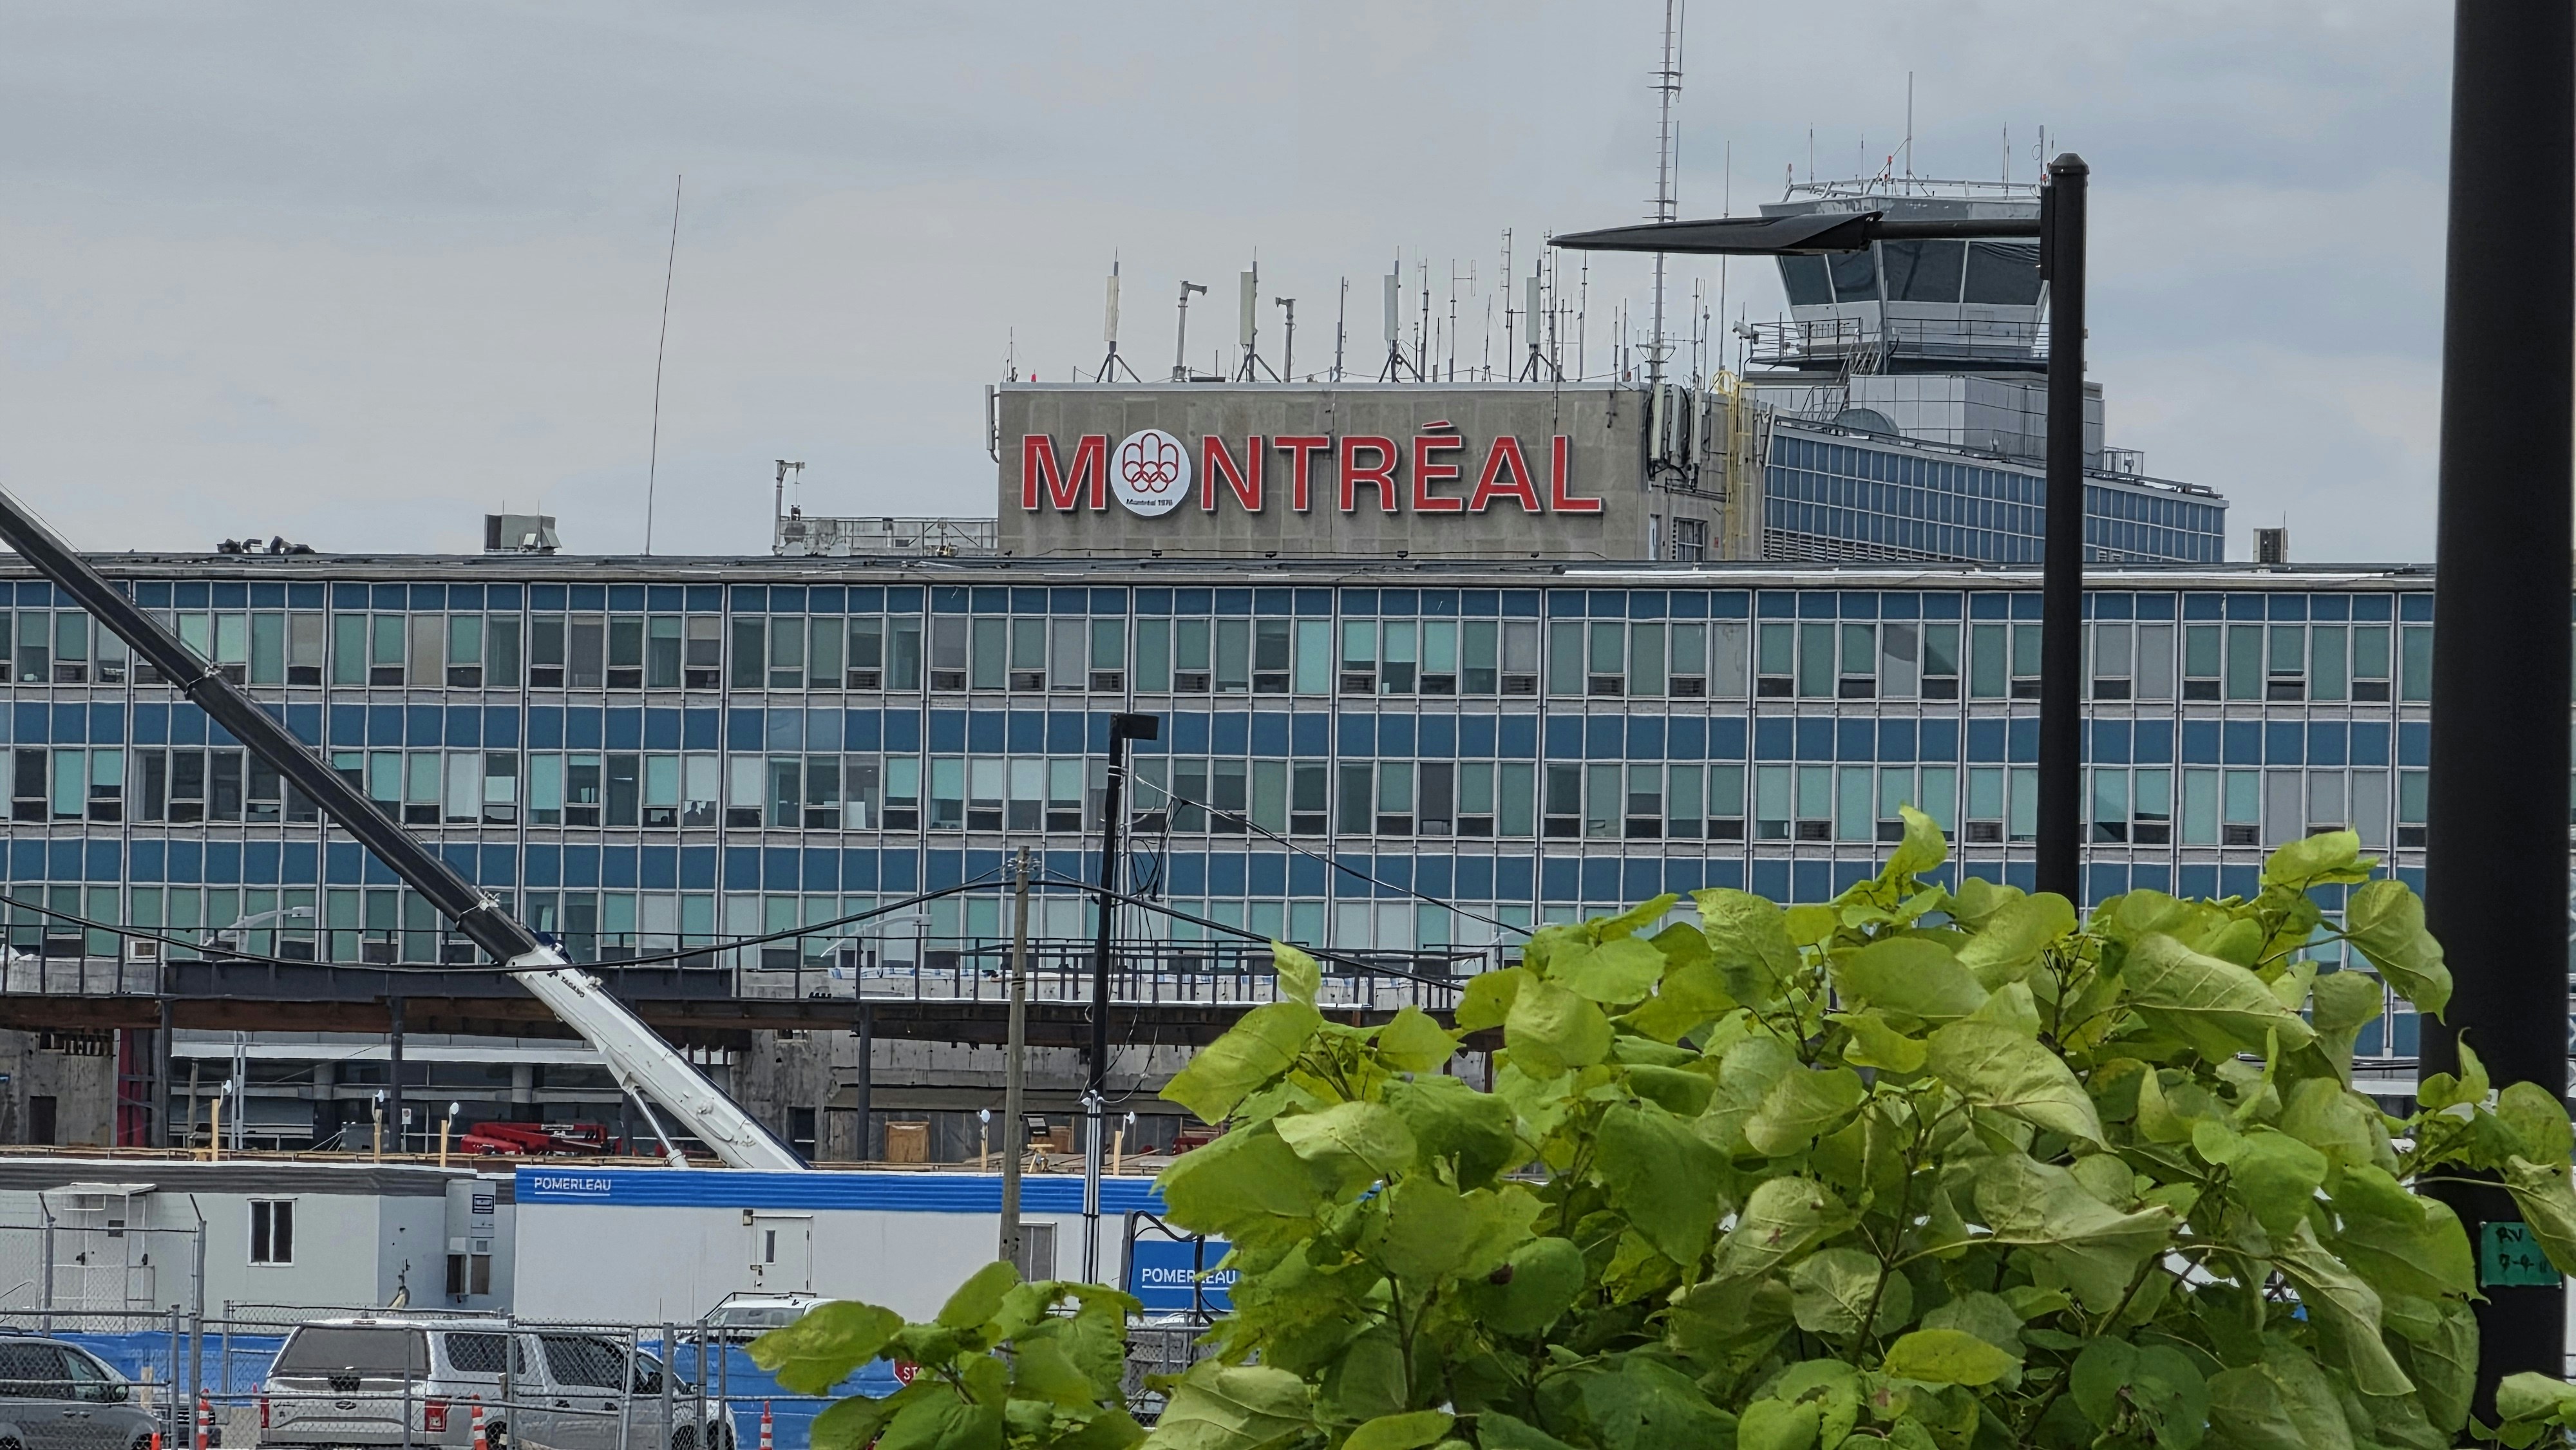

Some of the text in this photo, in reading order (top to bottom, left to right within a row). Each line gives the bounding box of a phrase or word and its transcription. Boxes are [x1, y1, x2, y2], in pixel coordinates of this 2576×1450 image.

[534, 1177, 611, 1191] POMERLEAU
[1142, 1268, 1236, 1284] POMEREAU
[904, 1366, 918, 1380] ST
